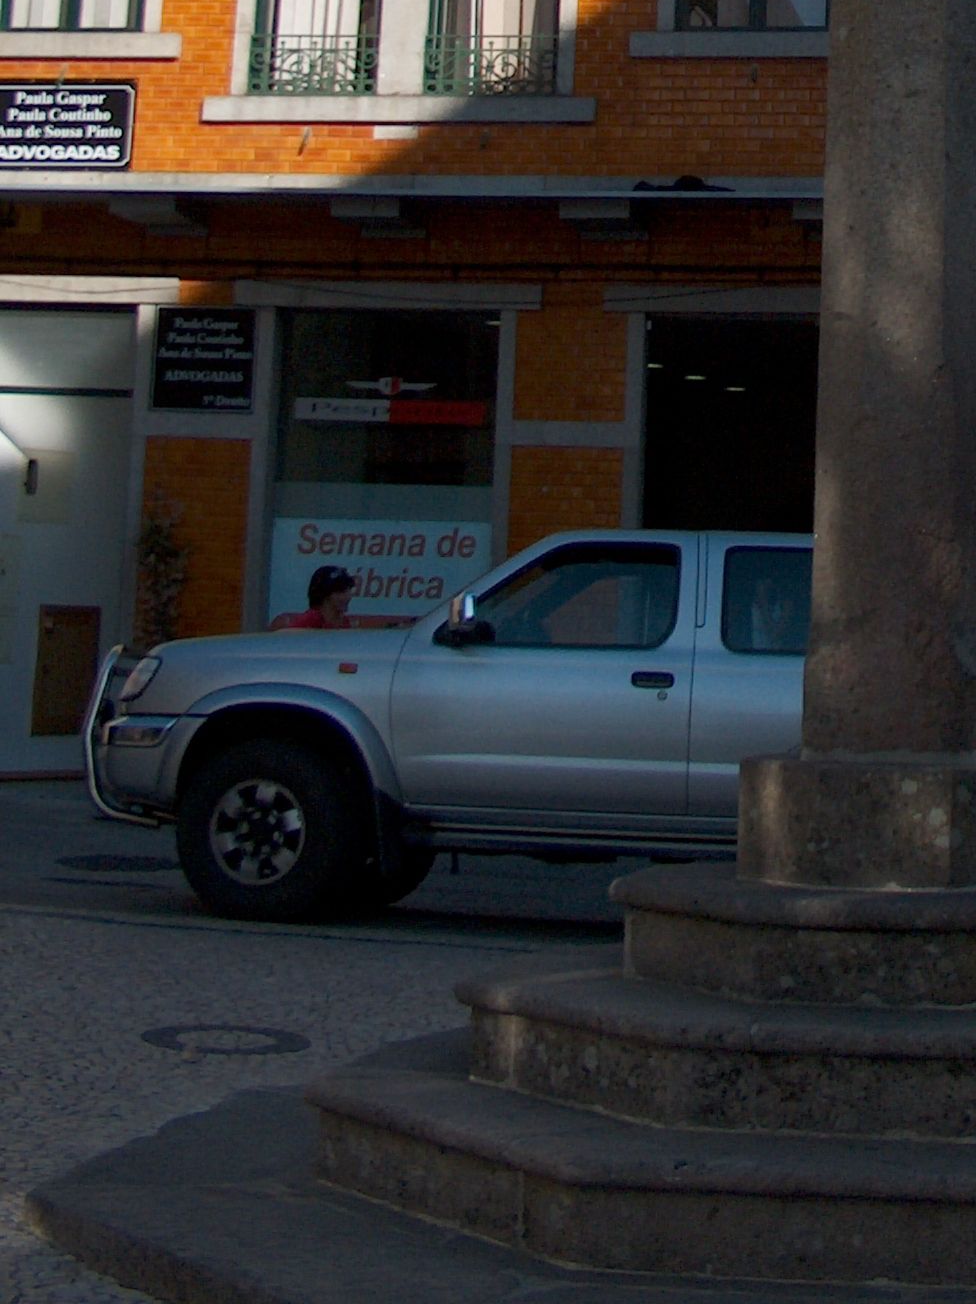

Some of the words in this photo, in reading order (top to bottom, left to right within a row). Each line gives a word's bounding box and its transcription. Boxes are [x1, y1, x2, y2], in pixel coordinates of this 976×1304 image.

[16, 91, 54, 105] Paula
[56, 91, 107, 108] Gaspar
[7, 108, 46, 122] Paula
[48, 108, 112, 122] Coutinho
[24, 125, 42, 139] de
[44, 125, 83, 139] Sousa
[85, 125, 123, 139] Pinto
[164, 369, 244, 383] ADVOGADAS
[297, 523, 426, 557] Semana
[437, 528, 476, 557] de
[352, 567, 444, 599] ábrica
